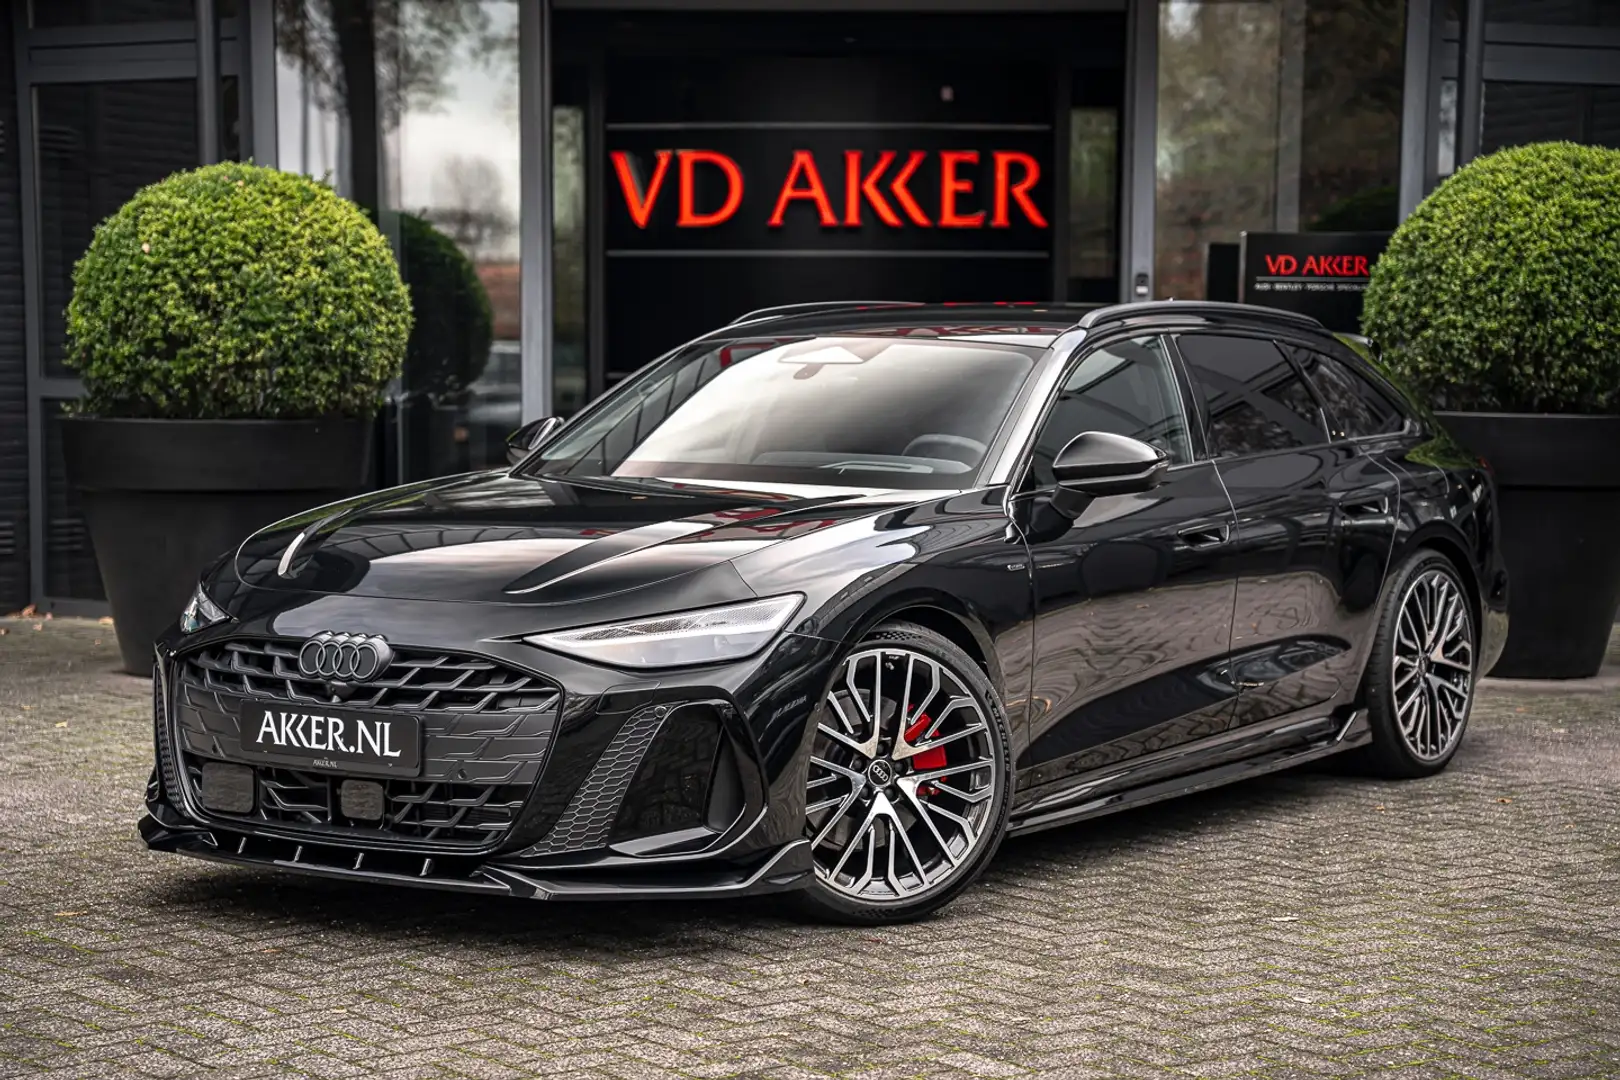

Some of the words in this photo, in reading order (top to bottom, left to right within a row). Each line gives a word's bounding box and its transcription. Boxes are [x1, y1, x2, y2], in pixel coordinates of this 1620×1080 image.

[610, 149, 744, 229] VD
[767, 149, 1048, 228] AKKER
[1265, 254, 1298, 275] VD
[1301, 255, 1369, 276] AKKER
[256, 710, 402, 757] AKKER.NL
